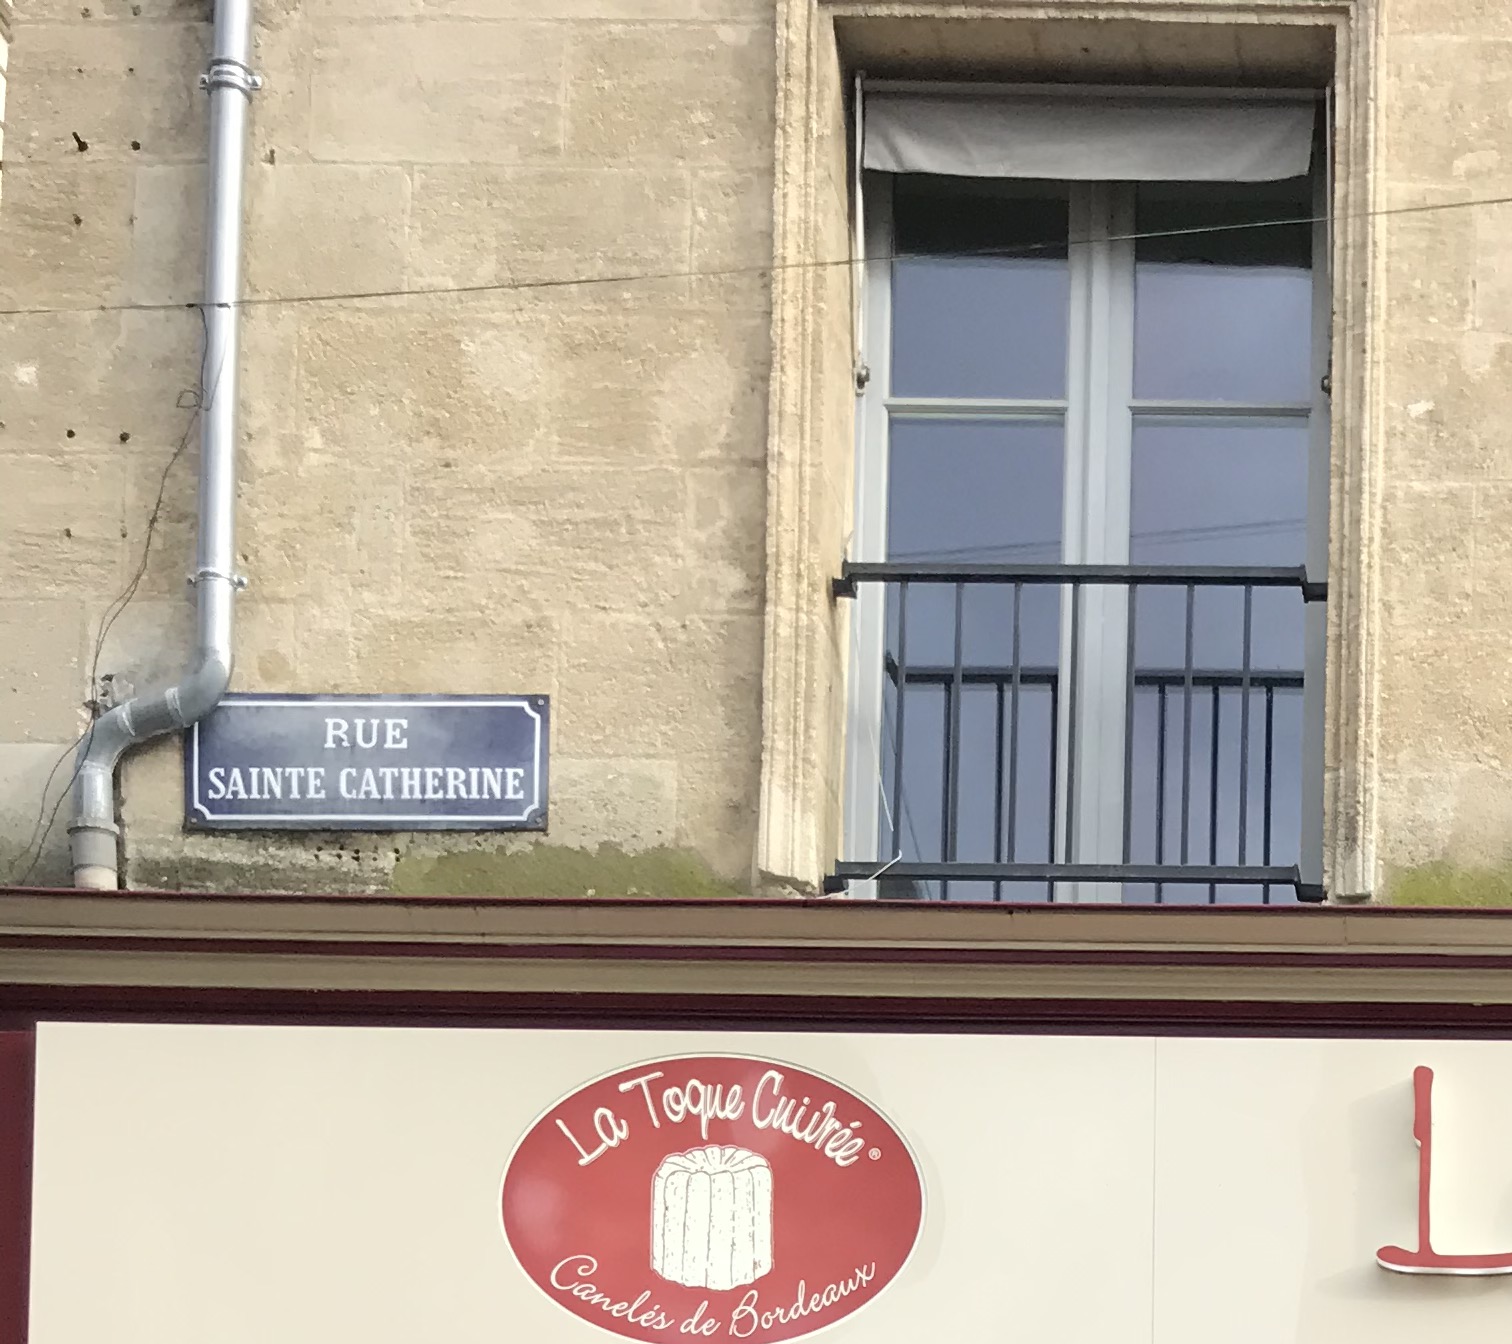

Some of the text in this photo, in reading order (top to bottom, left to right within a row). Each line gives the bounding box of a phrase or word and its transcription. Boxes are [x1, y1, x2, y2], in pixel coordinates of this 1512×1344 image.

[324, 718, 409, 749] RUE
[207, 766, 526, 802] SAINTE CATHERINE
[556, 1106, 629, 1168] La
[617, 1070, 748, 1141] Toque
[549, 1254, 878, 1340] Canelés de Bordeaux
